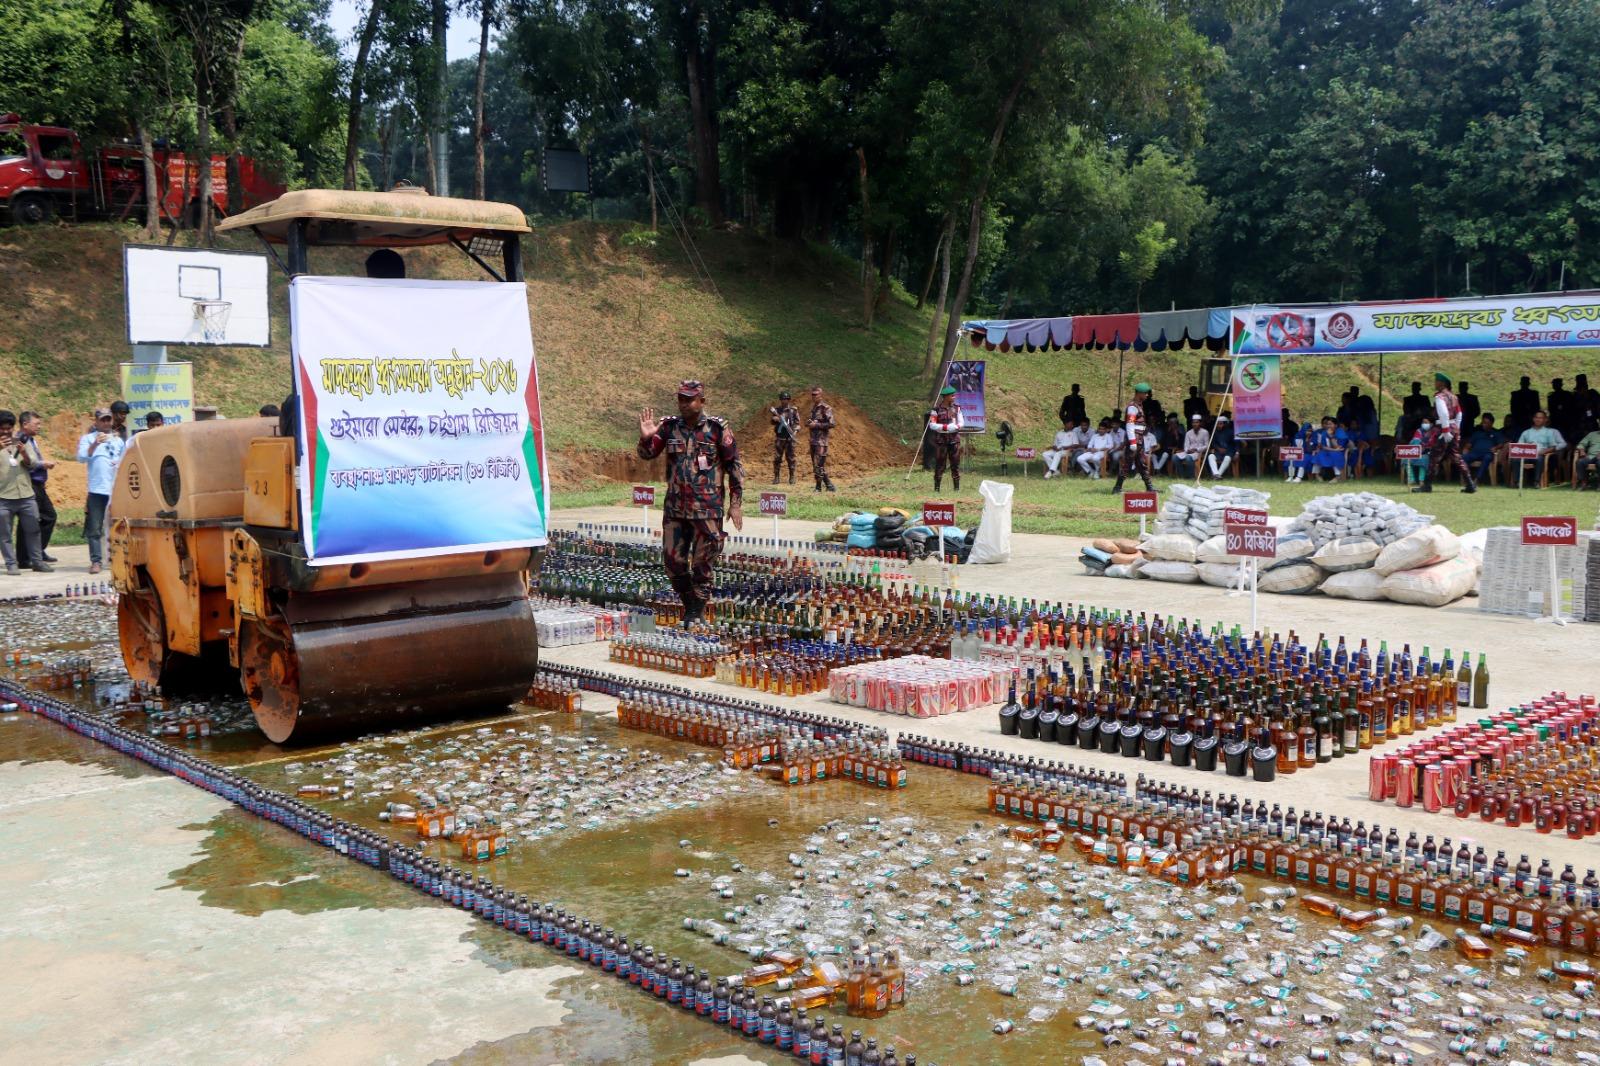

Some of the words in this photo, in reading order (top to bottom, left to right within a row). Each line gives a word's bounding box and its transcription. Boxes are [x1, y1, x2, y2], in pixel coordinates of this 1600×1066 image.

[1372, 308, 1507, 330] মাদকদ্রব্য
[1497, 328, 1572, 344] গুইমারা
[320, 357, 373, 401] মাদকদ্রব্য
[330, 409, 380, 443] গুইমারা
[428, 409, 469, 438] চট্টগ্রাম
[472, 407, 519, 434] রিজিয়ন
[1127, 498, 1154, 508] তামাক
[1227, 533, 1242, 550] ৪০
[1244, 529, 1276, 552] বিজিবি
[1526, 522, 1572, 538] সিগারেট
